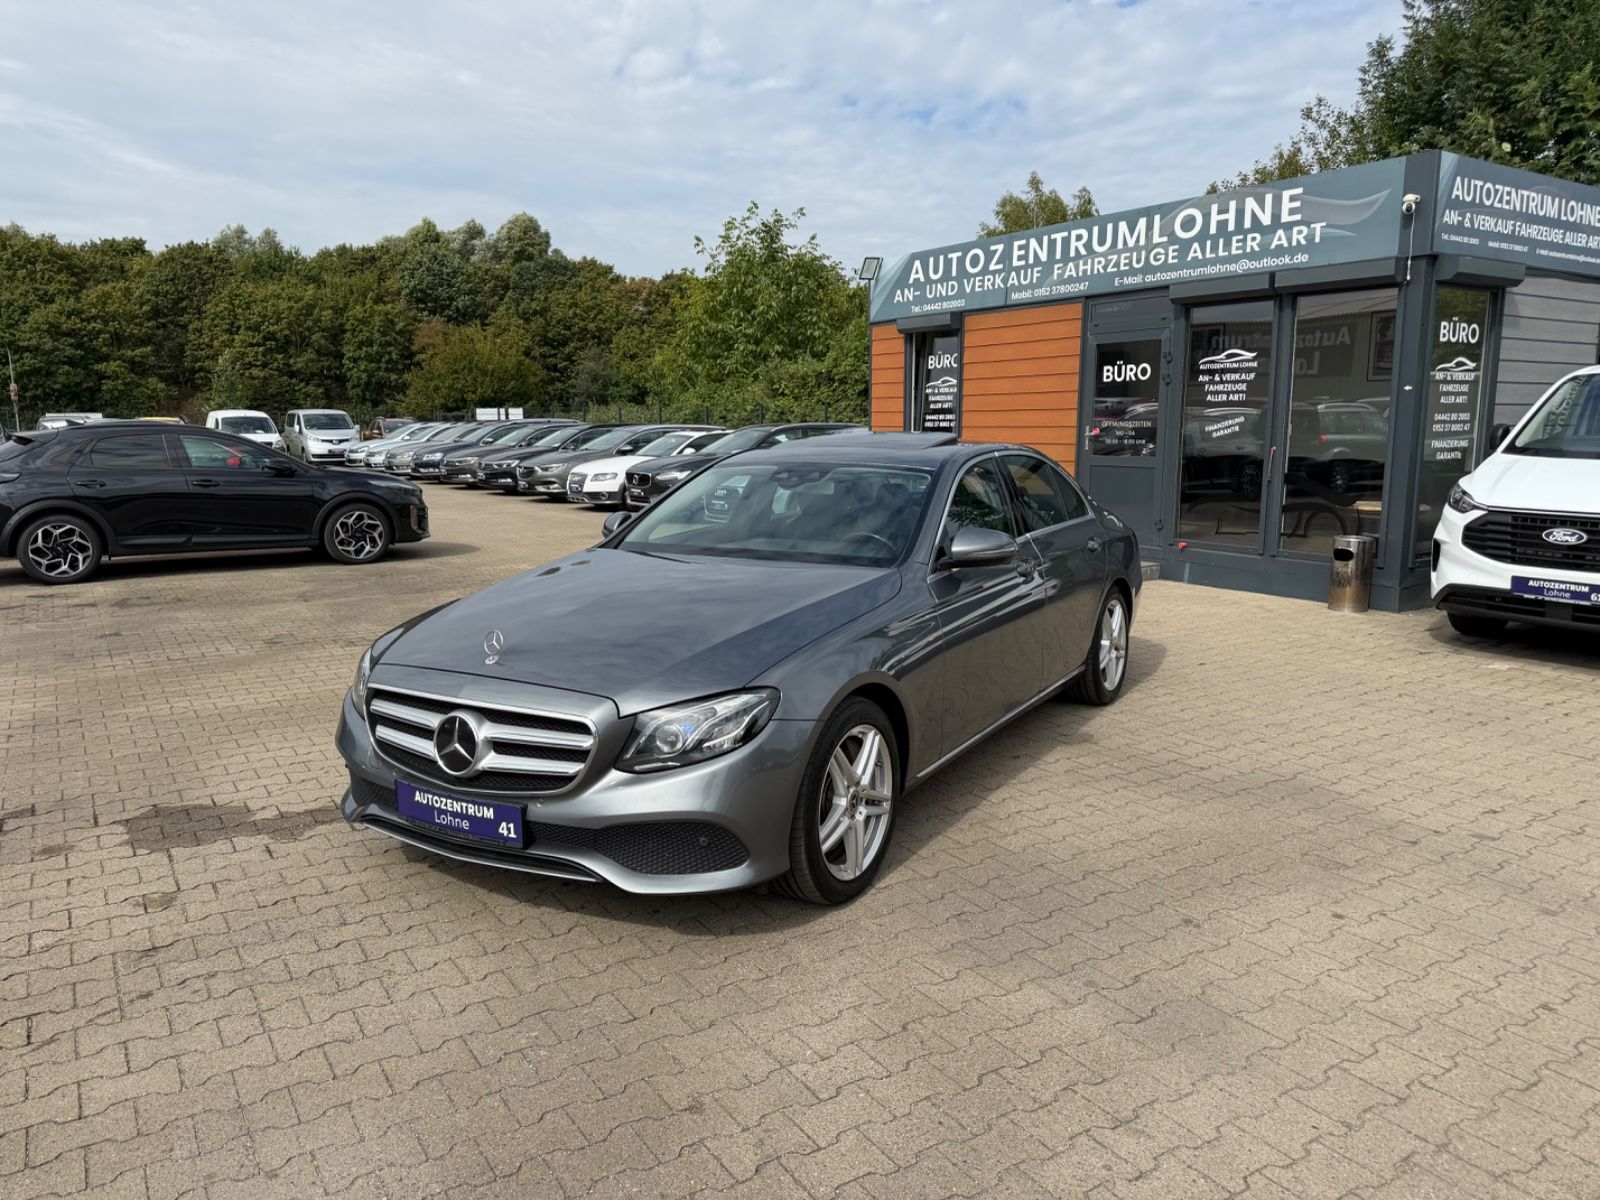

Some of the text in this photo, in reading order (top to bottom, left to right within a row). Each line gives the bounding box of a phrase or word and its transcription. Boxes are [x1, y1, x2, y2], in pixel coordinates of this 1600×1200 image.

[1451, 176, 1600, 227] AUTOZENTRUM LOHNE
[1442, 209, 1462, 226] AN-
[1463, 212, 1471, 228] &
[1473, 213, 1516, 235] VERKAUF
[1515, 222, 1564, 244] FAHRZEUGE
[1564, 231, 1587, 247] ALLER
[894, 221, 1327, 304] AN- UND VERKAUF FAHRZEUGE ALLER ART
[1144, 252, 1309, 282] autozentrumlohne@outlook.de
[1033, 286, 1051, 297] 0152
[1440, 317, 1480, 344] BÜRO
[1103, 360, 1151, 382] BÜRO
[1199, 362, 1239, 370] AUTOZENTRUM
[1198, 372, 1256, 382] AN- & VERKAUF
[1204, 383, 1247, 392] FAHRZEUGE
[1439, 383, 1469, 393] FAHRZEUGE
[1206, 394, 1227, 402] ALLER
[1431, 439, 1469, 448] FINANZIERUNG
[1549, 529, 1579, 543] Ford
[1527, 579, 1590, 593] AUTOZENTRUM
[1543, 588, 1571, 599] Lohne
[414, 790, 494, 819] AUTOZENTRUM
[434, 810, 470, 830] Lohne
[498, 821, 517, 838] 41
